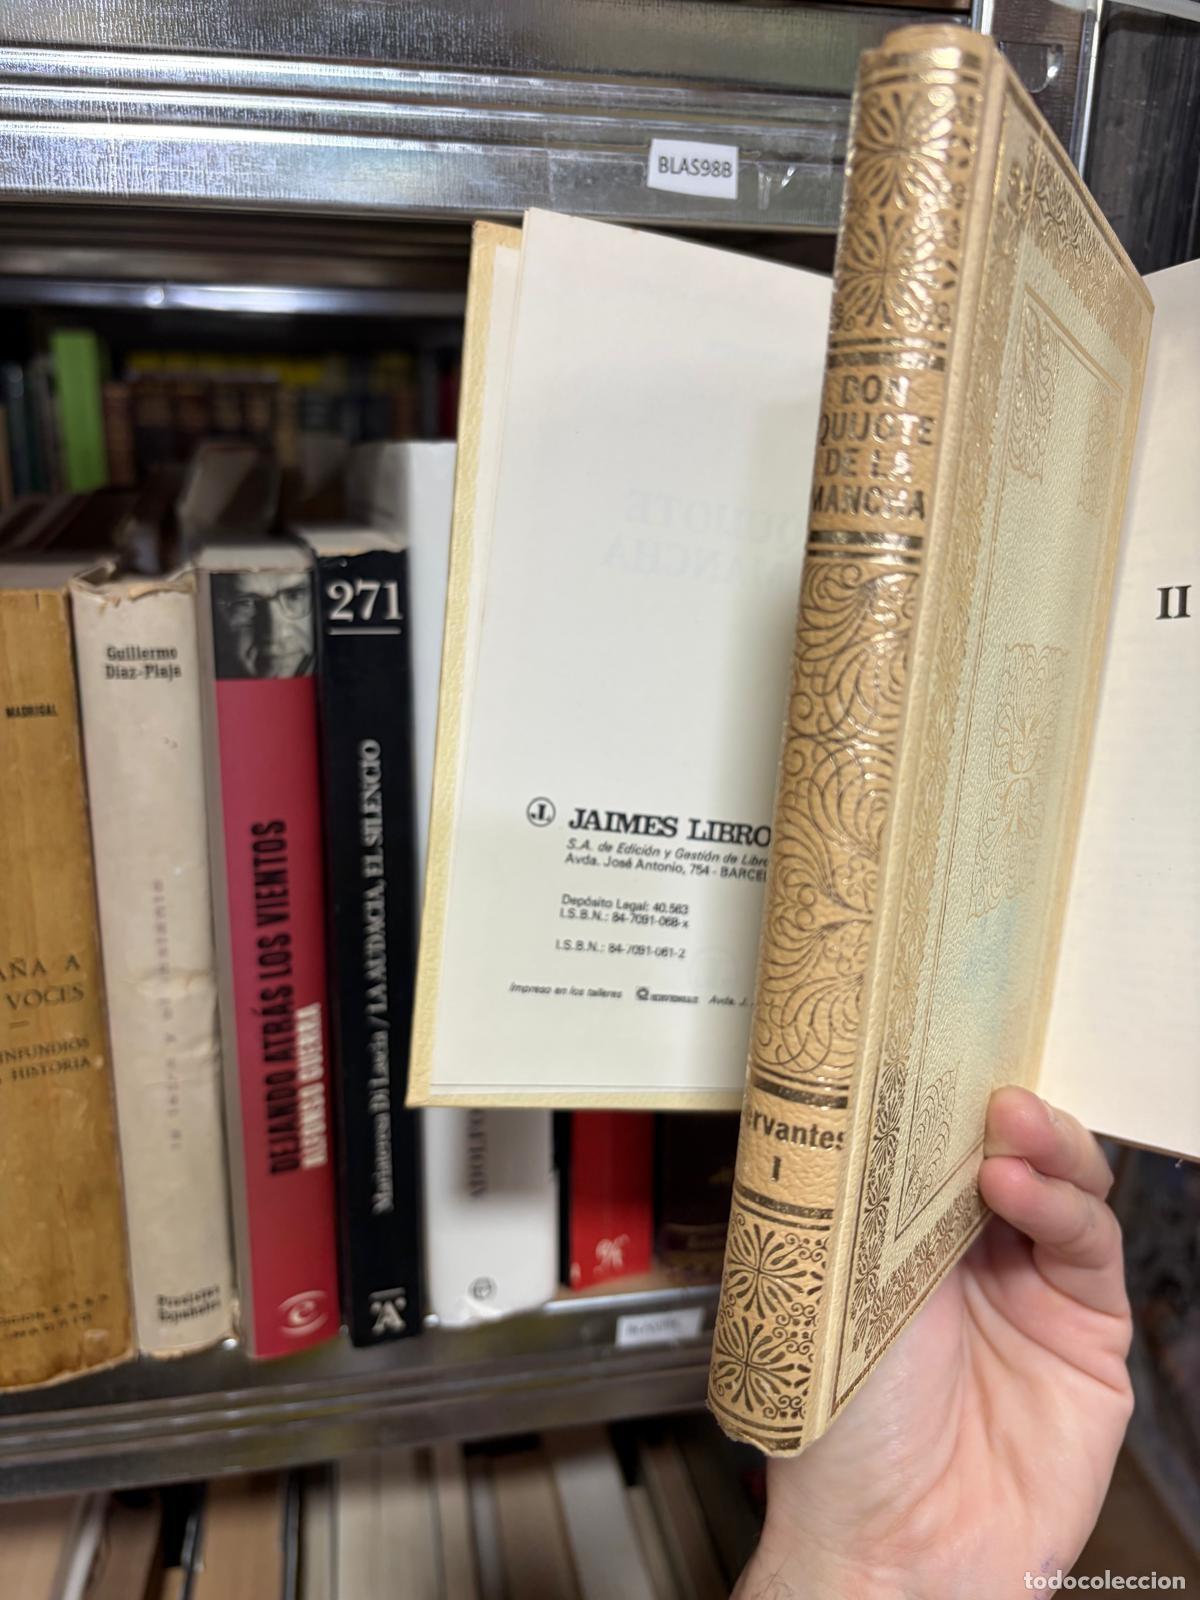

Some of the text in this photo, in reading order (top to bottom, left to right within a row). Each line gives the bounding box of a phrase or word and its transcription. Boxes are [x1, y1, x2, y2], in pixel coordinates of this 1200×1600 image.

[658, 156, 732, 178] BLAS98B
[825, 448, 857, 477] DE
[327, 579, 403, 622] 271
[1155, 584, 1192, 620] II
[106, 645, 178, 662] Guillermo
[359, 739, 383, 847] SILENCIO
[568, 807, 679, 838] JAIMES
[361, 848, 384, 878] EL
[565, 853, 599, 868] Avda.
[603, 856, 632, 870] José
[635, 859, 686, 876] Antonio,
[690, 863, 710, 876] 754
[566, 837, 593, 851] S.A.
[597, 841, 613, 853] de
[616, 842, 660, 858] Edición
[664, 848, 672, 860] y
[674, 847, 720, 863] Gestión
[722, 854, 738, 864] de
[561, 893, 614, 909] Depósito
[251, 820, 300, 1175] DEJANDO ATRÁS LOS VIENTOS
[749, 1109, 846, 1151] rvantes
